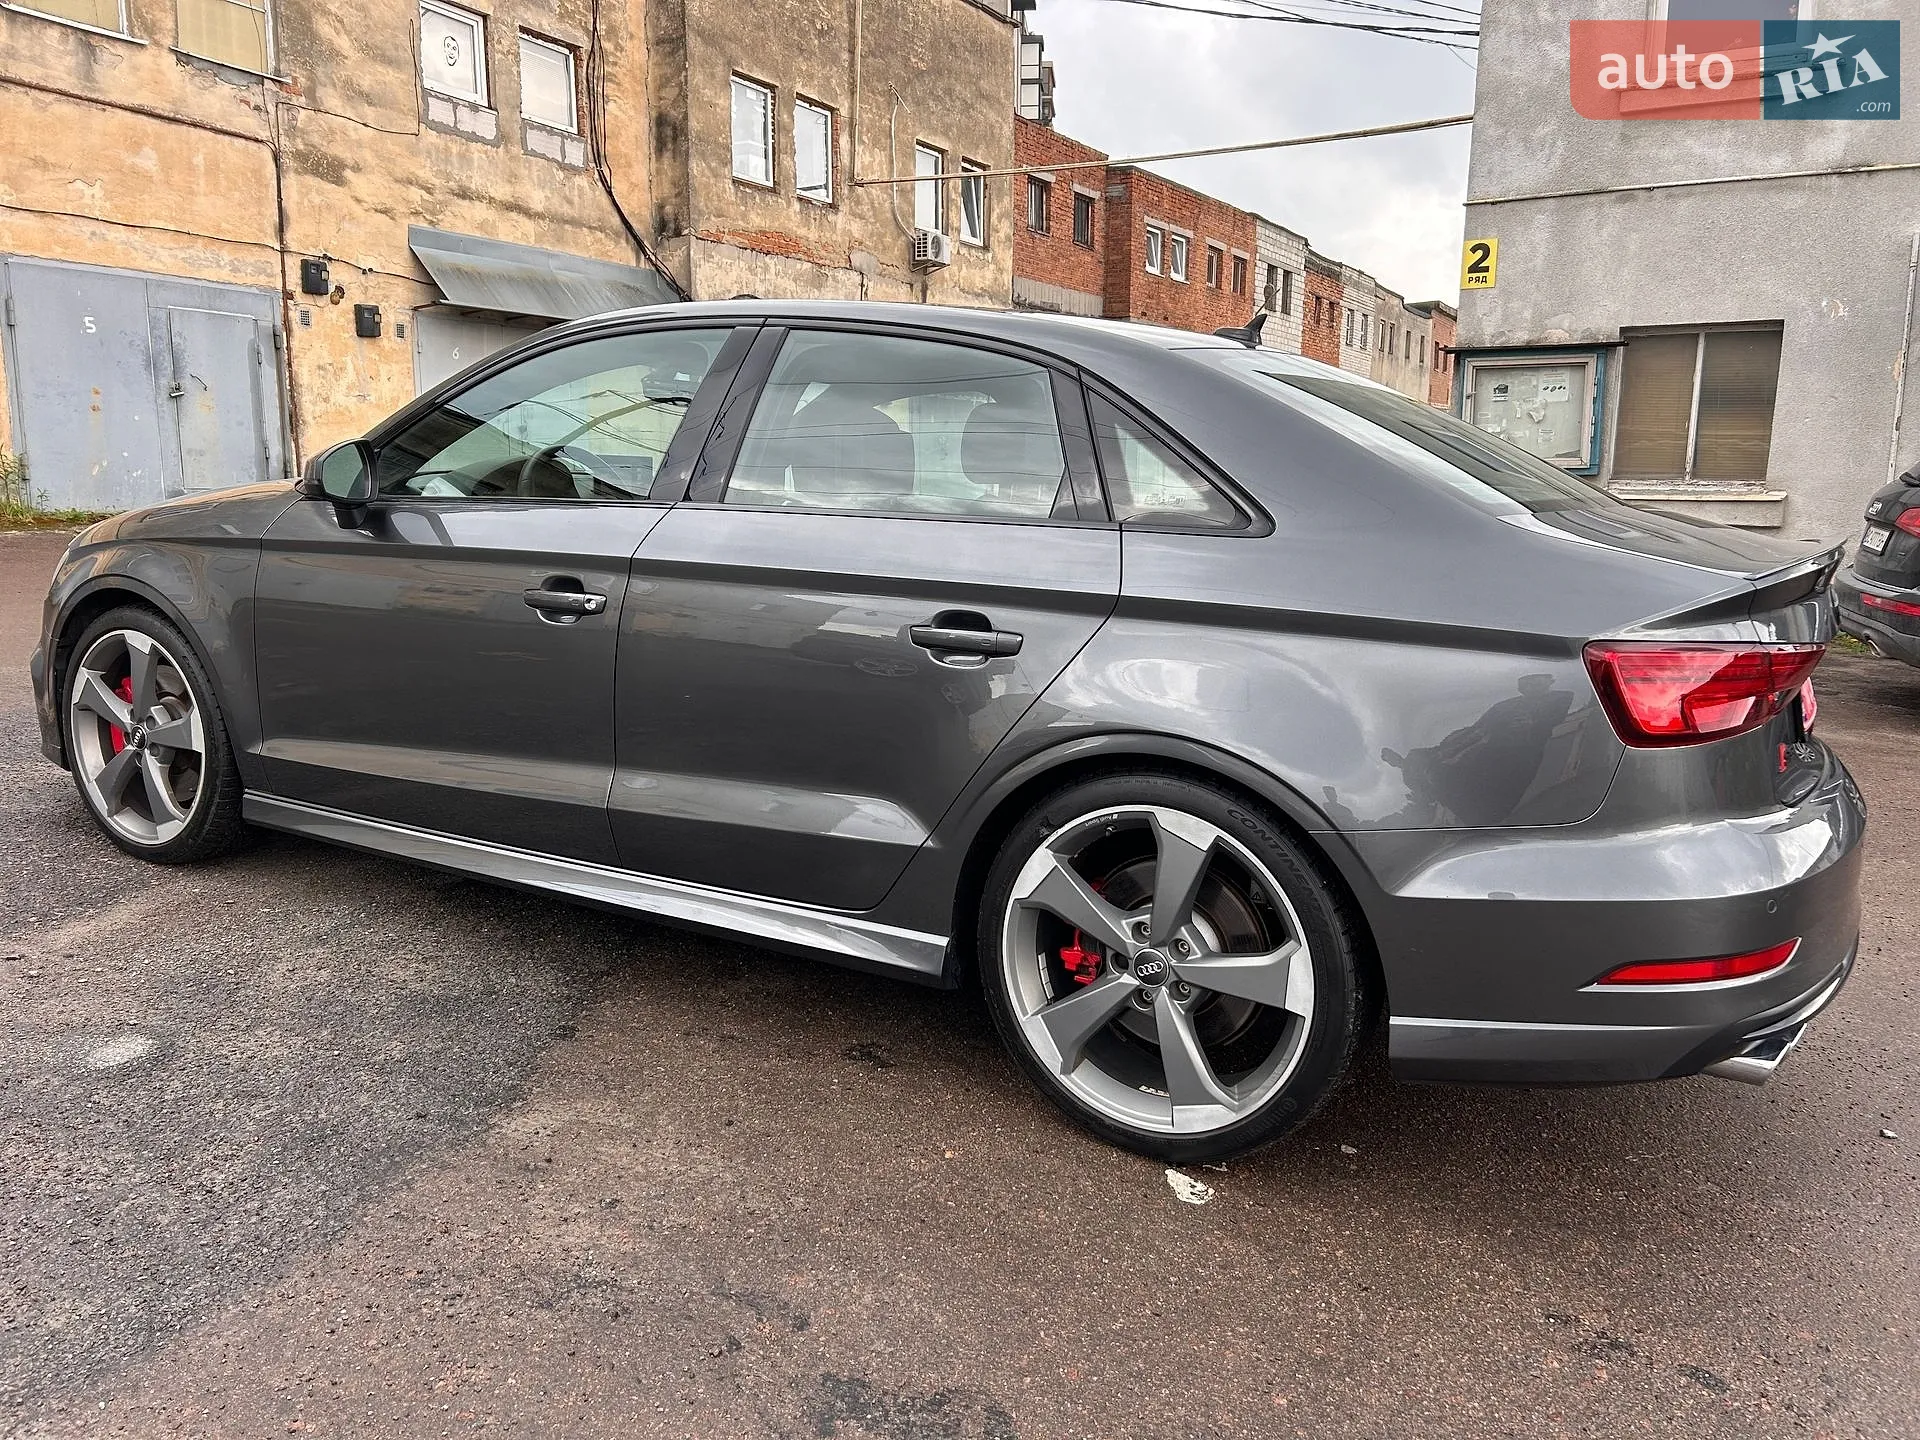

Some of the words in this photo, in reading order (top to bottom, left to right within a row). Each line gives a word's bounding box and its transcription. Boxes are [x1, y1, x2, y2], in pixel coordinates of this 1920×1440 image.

[1467, 242, 1491, 274] 2
[1467, 275, 1488, 285] РЯД
[84, 316, 97, 334] 5
[452, 347, 460, 360] 6
